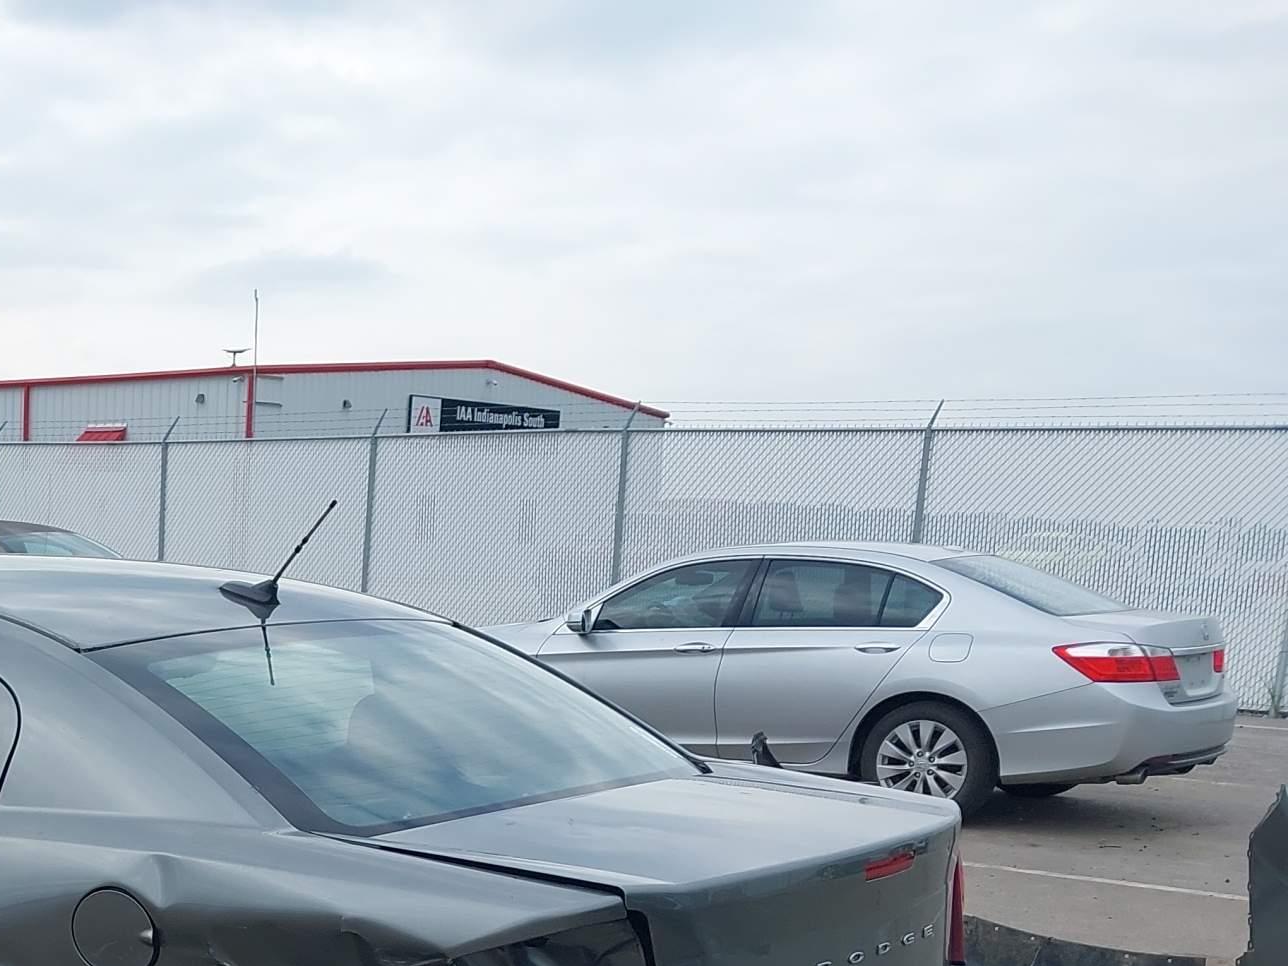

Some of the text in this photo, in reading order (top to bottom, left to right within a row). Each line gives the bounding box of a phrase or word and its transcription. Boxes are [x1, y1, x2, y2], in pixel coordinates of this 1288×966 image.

[456, 405, 545, 428] IAA Indianapolis South
